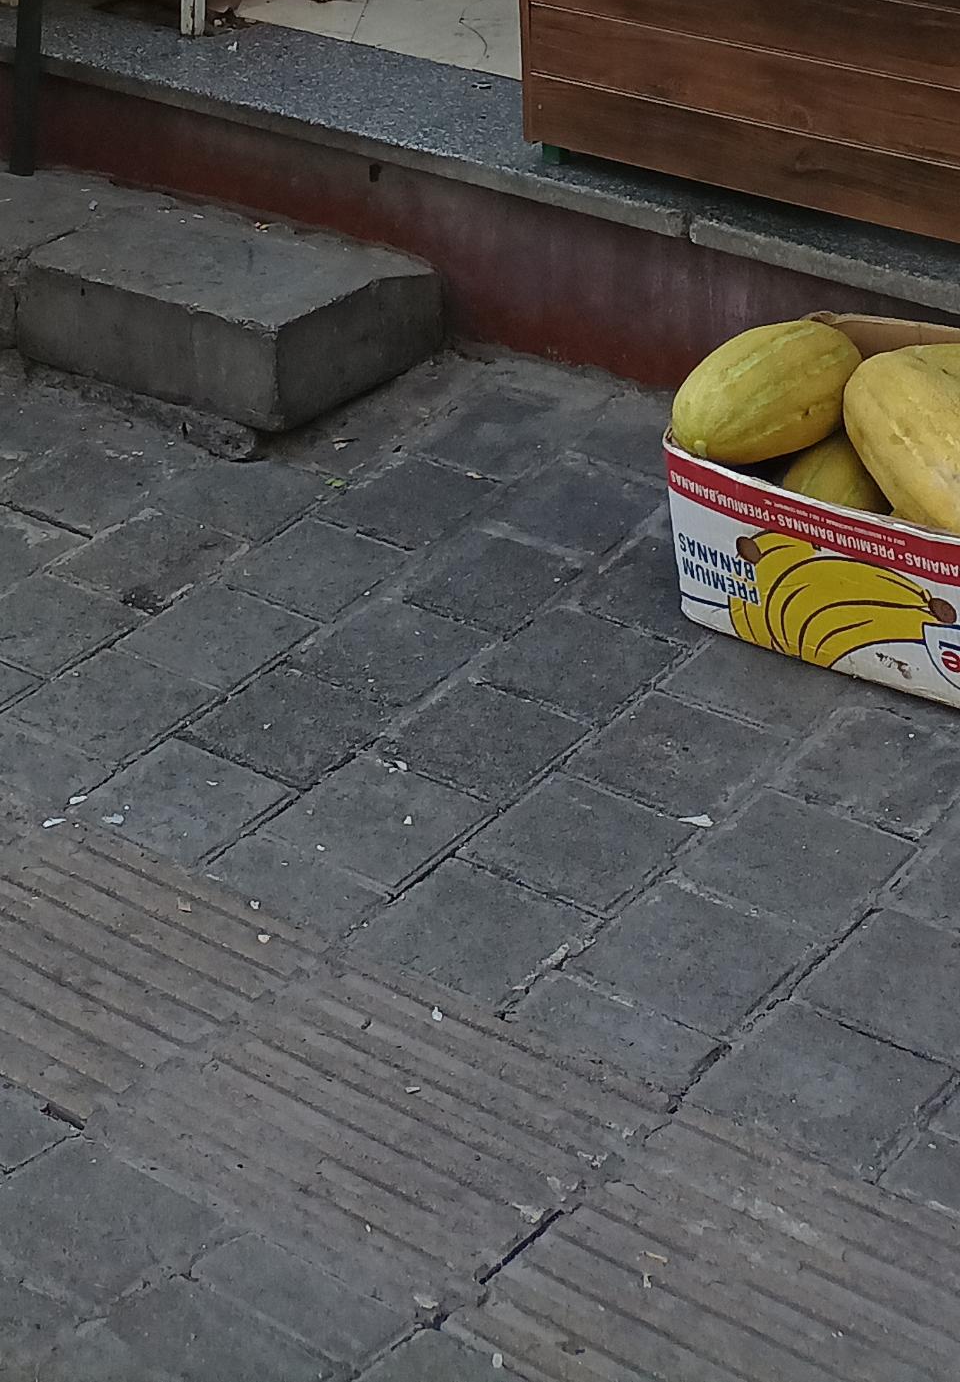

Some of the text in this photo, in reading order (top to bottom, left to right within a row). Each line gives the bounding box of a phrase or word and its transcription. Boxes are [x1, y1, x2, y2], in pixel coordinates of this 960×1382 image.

[670, 470, 716, 504] BANANAS
[718, 494, 770, 522] PREMIUM
[777, 513, 835, 544] BANANAS
[678, 532, 755, 582] BANANAS
[836, 532, 896, 561] PREMIUM
[905, 552, 960, 578] ANANAS
[681, 556, 760, 606] PREMIUM
